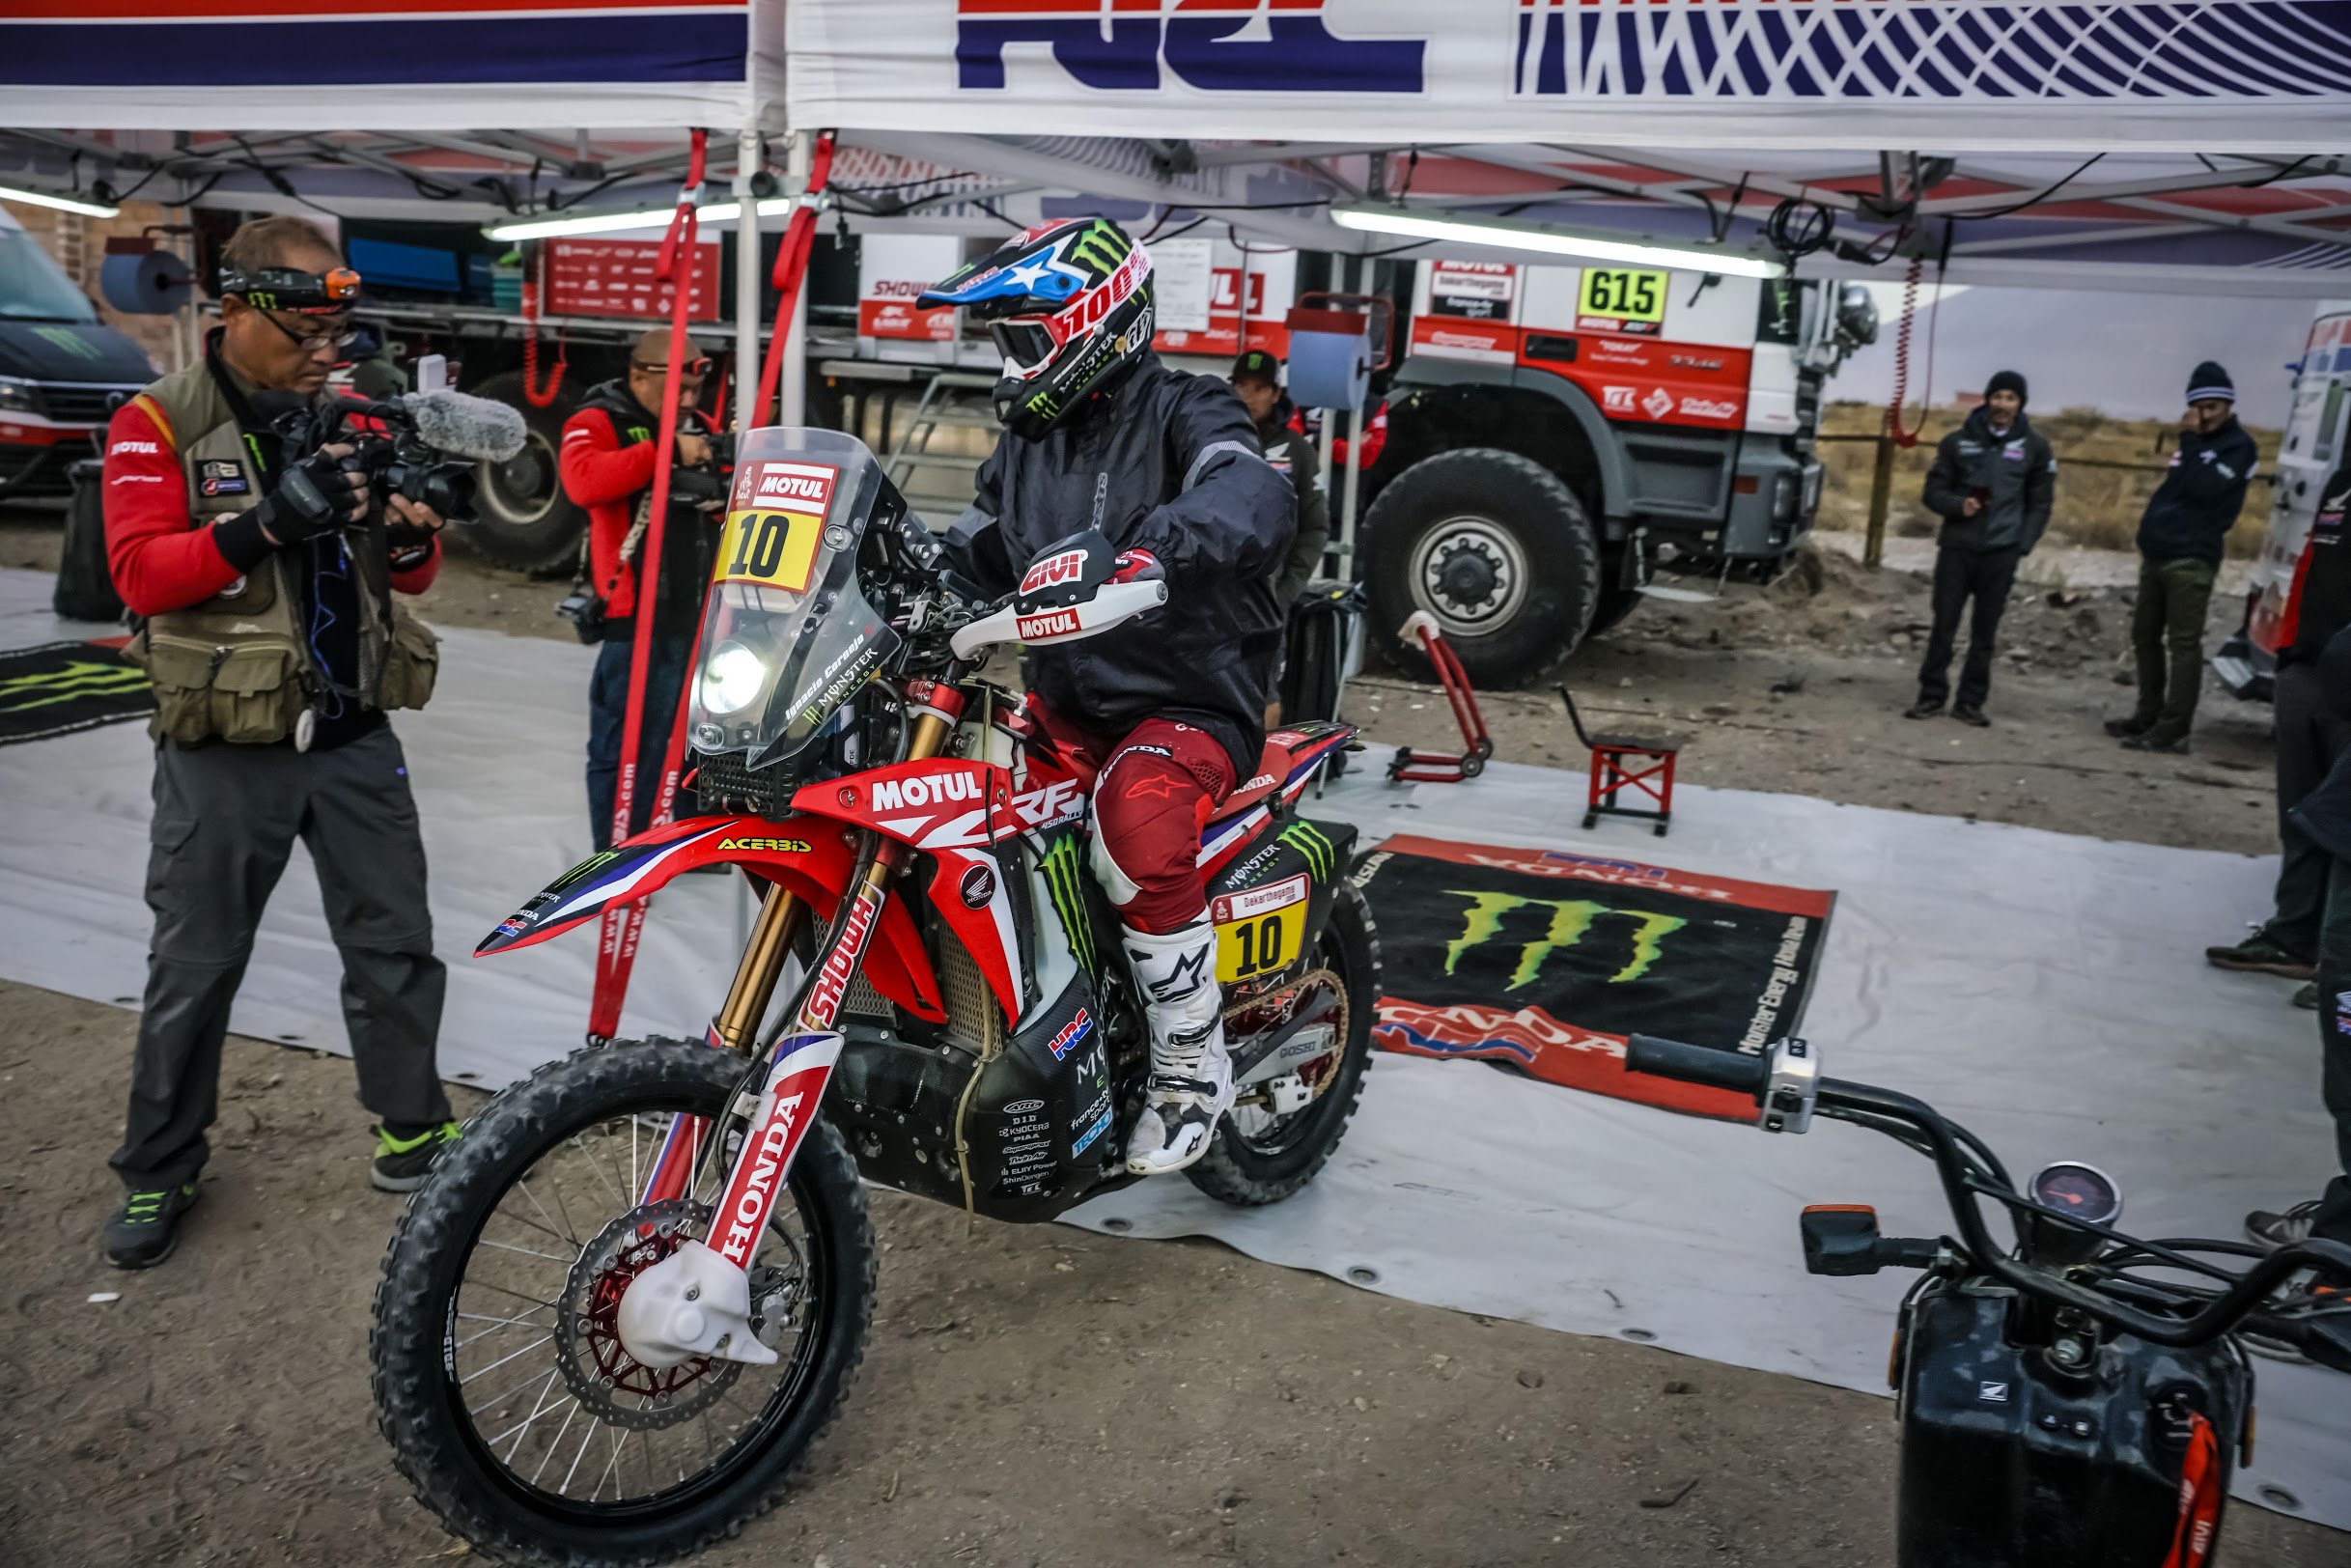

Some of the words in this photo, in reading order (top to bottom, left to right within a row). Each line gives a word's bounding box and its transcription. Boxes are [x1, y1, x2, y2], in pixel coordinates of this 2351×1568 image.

[1589, 271, 1657, 315] 615
[760, 476, 824, 503] MOTUL
[728, 514, 790, 578] 10
[1021, 553, 1079, 593] GIVI
[1021, 613, 1078, 638] MOTUL
[785, 677, 824, 721] Ignacio
[825, 633, 865, 680] Cornejo
[818, 647, 879, 707] MONSTER
[836, 663, 876, 705] ENERGY
[872, 771, 983, 812] MOTUL
[717, 837, 813, 853] ACERBIS
[1225, 843, 1282, 889] MONSTER
[1244, 857, 1280, 890] ENERGY
[1236, 914, 1282, 978] 10
[1048, 1007, 1094, 1061] HRC
[1279, 1041, 1316, 1059] GOSHI
[1737, 1005, 1777, 1056] Monster
[1013, 1133, 1040, 1143] PIAA
[721, 1091, 804, 1263] HONDA
[1002, 1171, 1050, 1185] ShinDengen
[1032, 1161, 1058, 1171] Power
